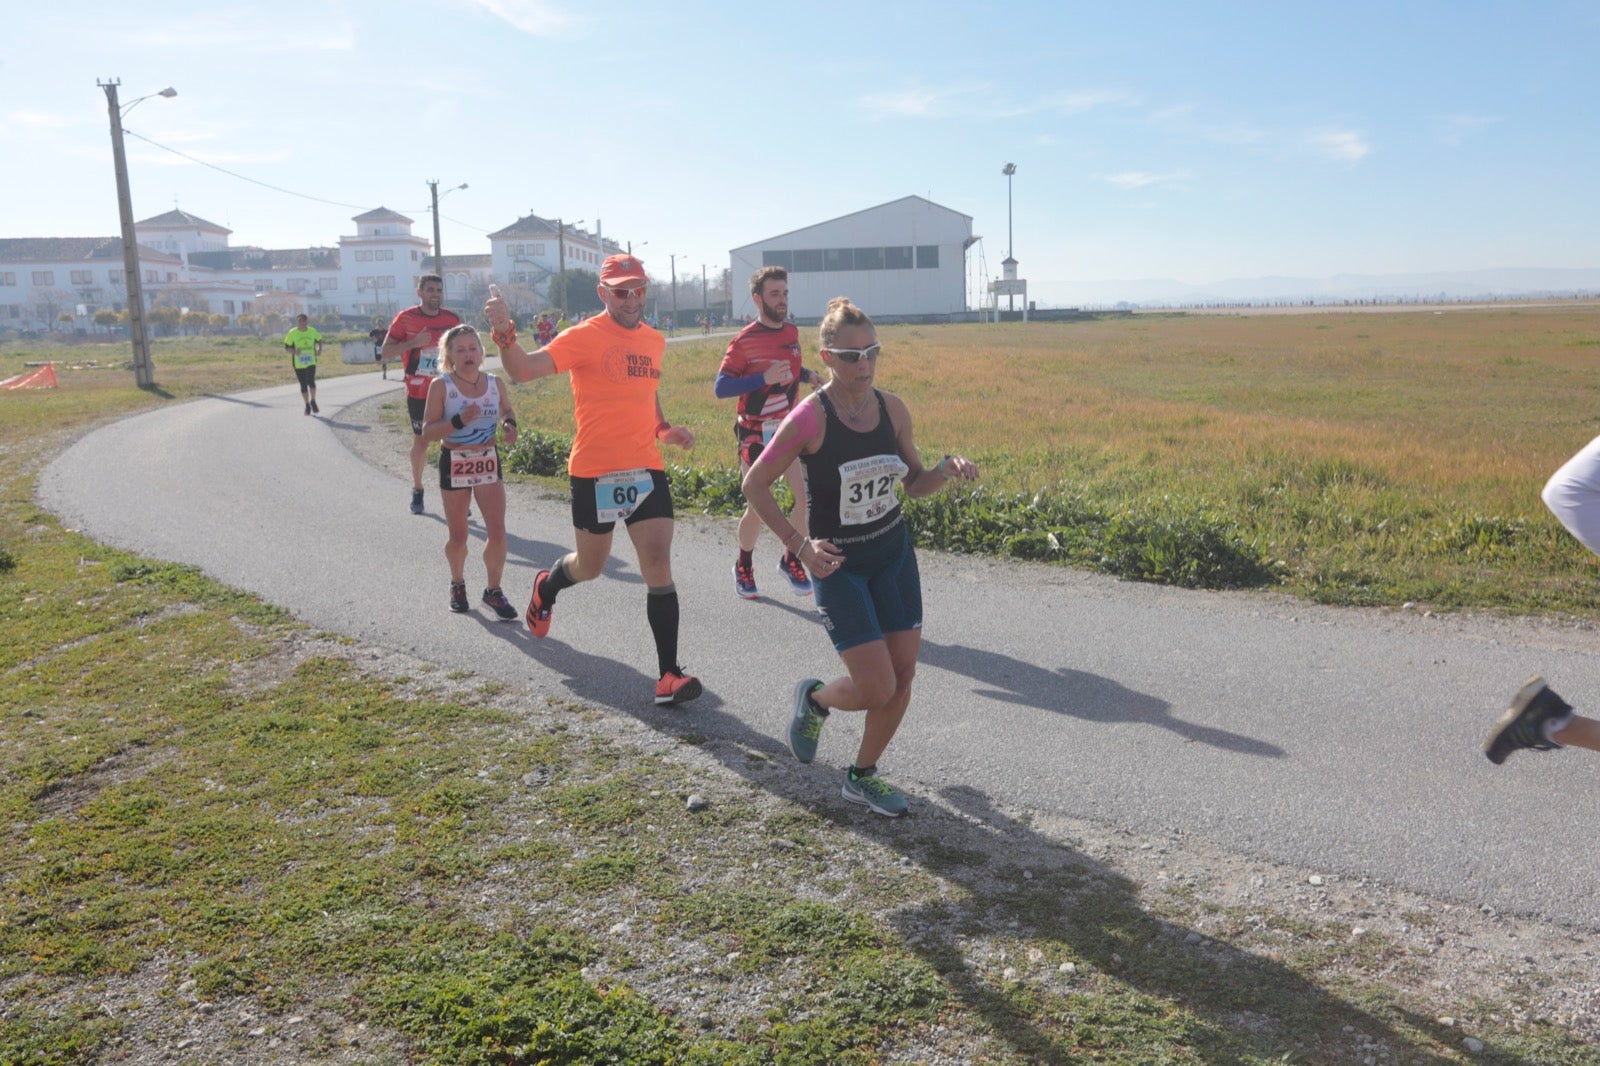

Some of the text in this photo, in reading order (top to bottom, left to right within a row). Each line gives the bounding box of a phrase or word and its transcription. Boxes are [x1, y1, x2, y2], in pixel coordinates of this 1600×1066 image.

[626, 354, 653, 367] YO SOY
[627, 366, 649, 378] BEER
[453, 459, 495, 475] 2280
[613, 486, 638, 505] 60
